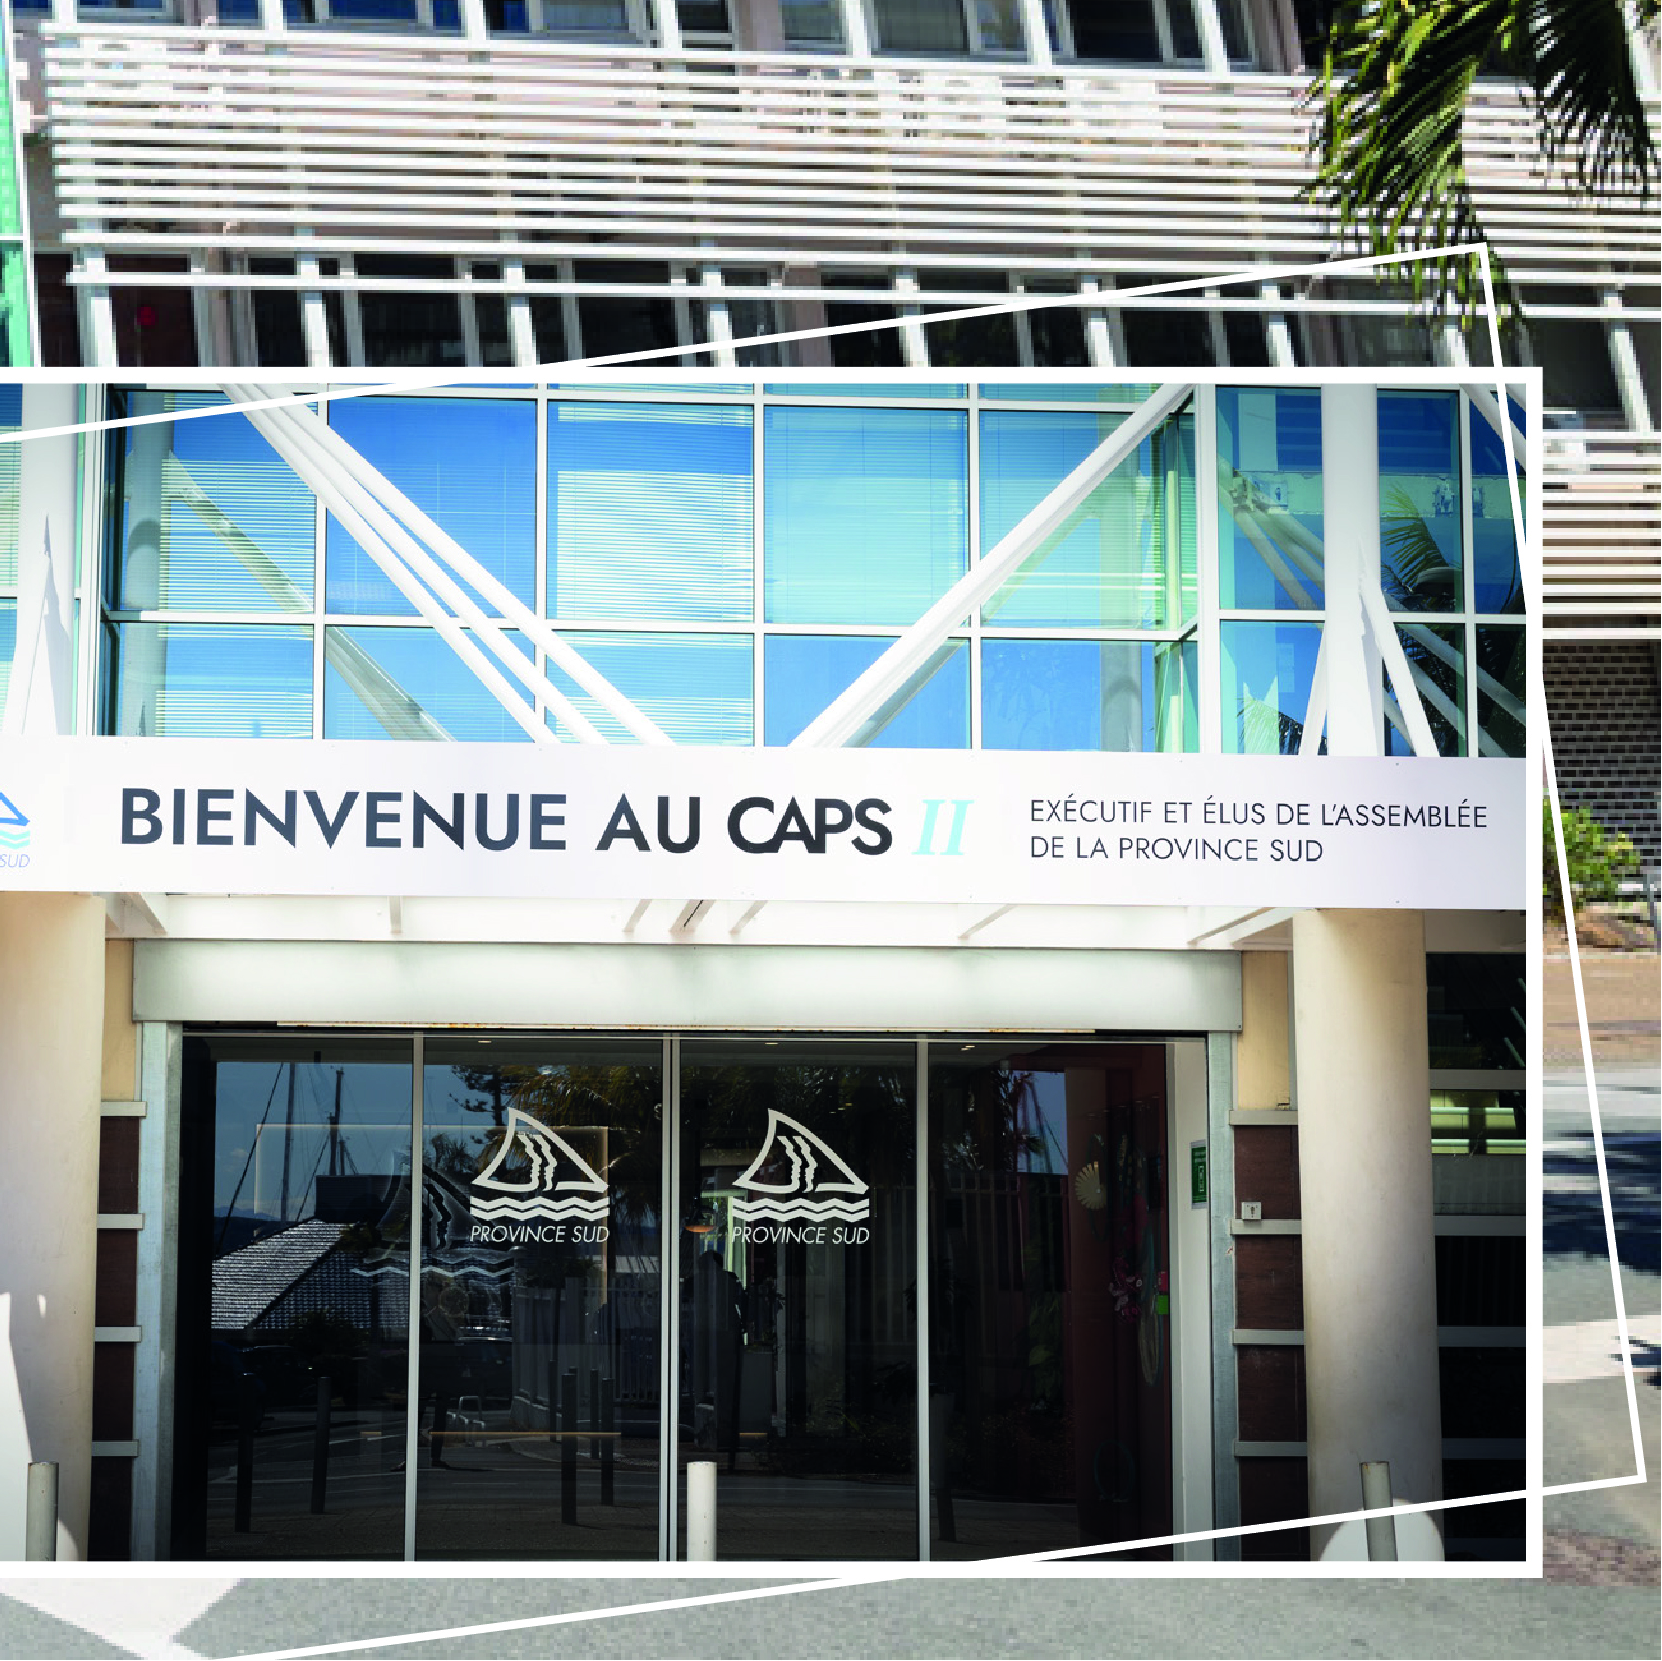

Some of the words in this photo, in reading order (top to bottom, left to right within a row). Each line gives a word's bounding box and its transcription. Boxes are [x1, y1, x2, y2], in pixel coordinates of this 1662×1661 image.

[121, 788, 567, 851] BIENVENUE
[595, 793, 701, 853] AU
[727, 795, 893, 856] CAPS
[1030, 793, 1152, 823] EXÉCUTIF
[1164, 801, 1192, 823] ET
[1203, 795, 1266, 825] ÉLUS
[1277, 803, 1310, 825] DE
[1321, 798, 1487, 828] L'ASSEMBLÉE
[1030, 836, 1064, 858] DE
[1076, 837, 1109, 859] LA
[1119, 837, 1258, 861] PROVINCE
[1270, 839, 1323, 862] SUD
[470, 1225, 566, 1243] PROVINCE
[571, 1225, 610, 1243] SUD
[732, 1226, 828, 1244] PROVINCE
[832, 1227, 870, 1245] SUD
